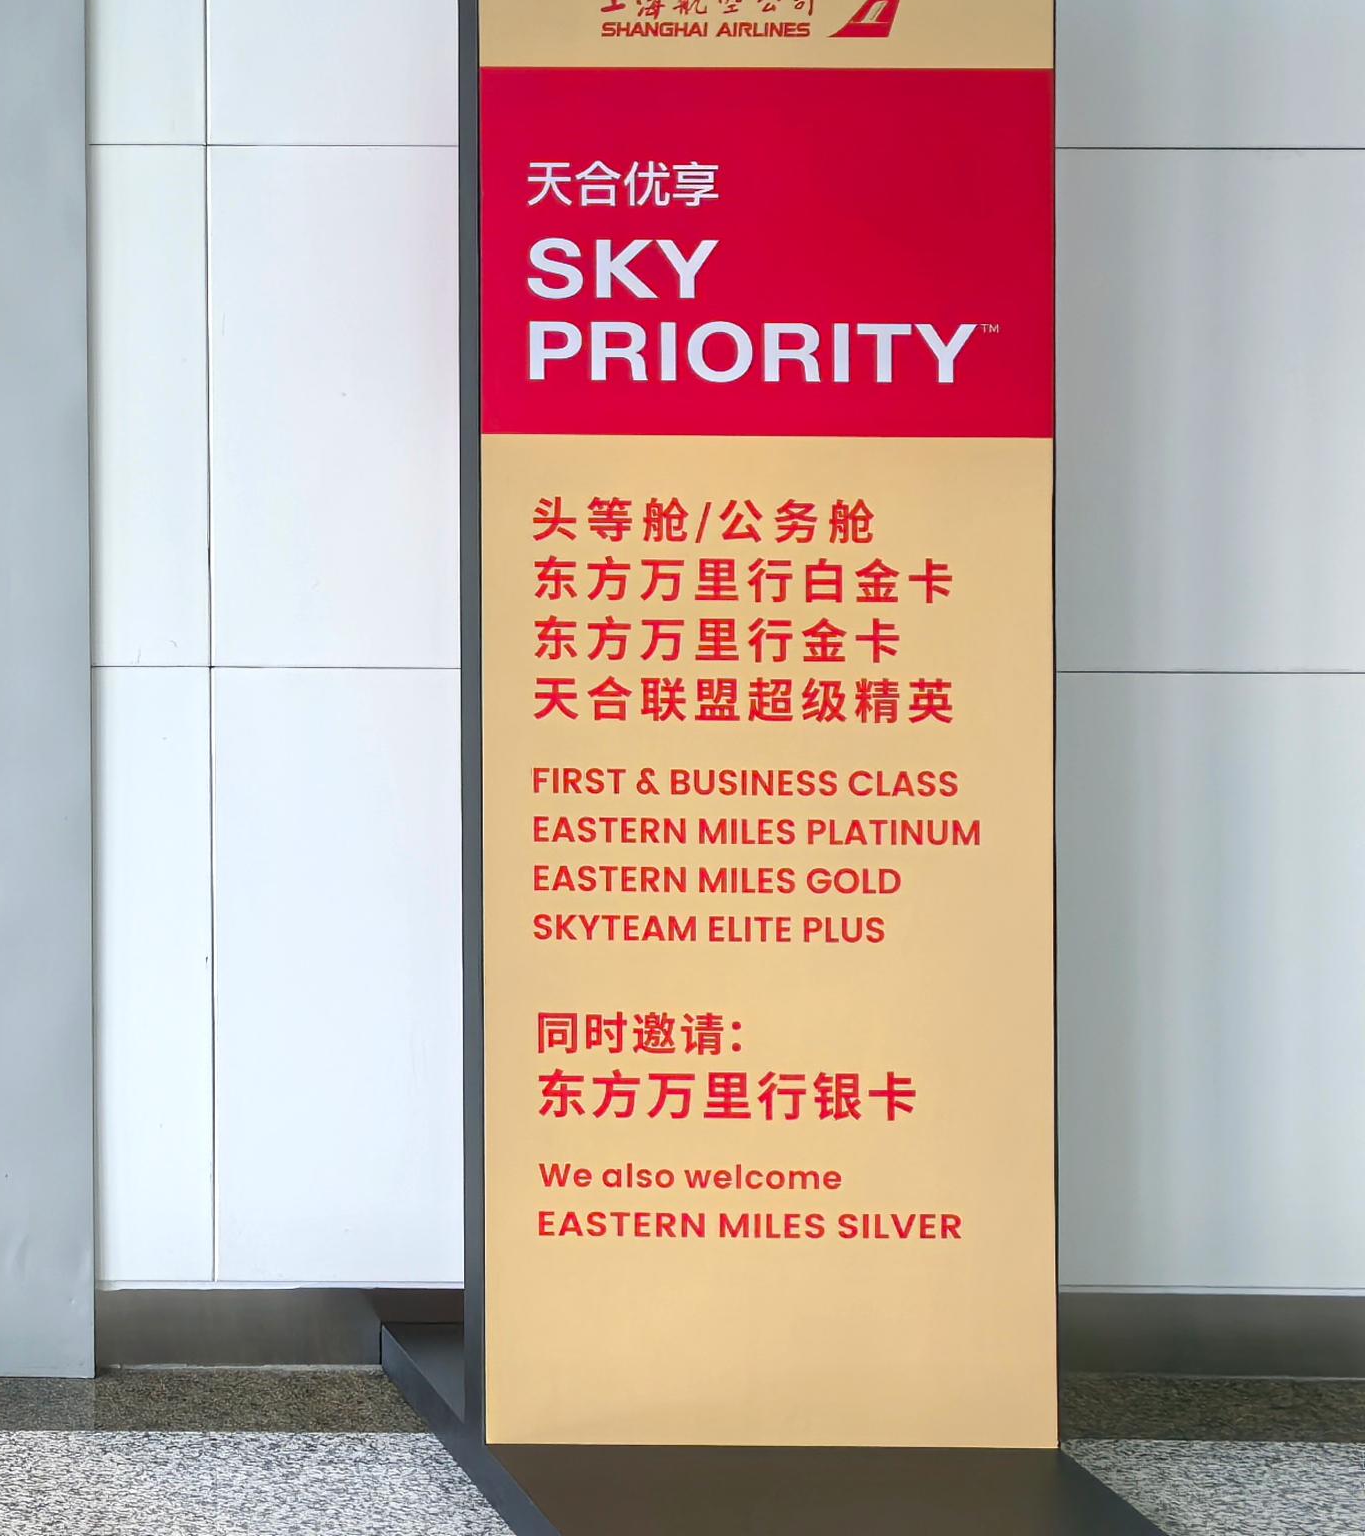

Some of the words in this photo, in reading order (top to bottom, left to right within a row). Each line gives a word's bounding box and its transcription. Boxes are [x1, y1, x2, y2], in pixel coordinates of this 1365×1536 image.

[601, 21, 708, 37] SHANGHAI
[716, 22, 811, 38] AIRLINES
[527, 161, 719, 207] 天合优享
[527, 237, 719, 299] SKY
[529, 321, 978, 383] PRIORITY
[533, 496, 875, 544] 头等舱/公务舱
[534, 555, 954, 604] 东方万里行白金卡
[534, 615, 901, 663] 东方万里行金卡
[533, 675, 954, 724] 天合联盟超级精英
[533, 767, 627, 795] FIRST
[636, 768, 661, 796] &
[670, 769, 838, 797] BUSINESS
[848, 770, 959, 798] CLASS
[533, 816, 687, 845] EASTERN
[698, 818, 796, 845] MILES
[807, 820, 981, 846] PLATINUM
[533, 865, 687, 893] EASTERN
[698, 867, 796, 894] MILES
[806, 868, 902, 895] GOLD
[533, 914, 697, 942] SKYTEAM
[708, 916, 792, 943] ELITE
[803, 917, 886, 944] PLUS
[538, 1068, 917, 1122] 东方万里行银卡
[539, 1163, 593, 1189] We
[601, 1162, 675, 1189] also
[684, 1163, 842, 1190] welcome
[538, 1210, 706, 1238] EASTERN
[719, 1212, 825, 1239] MILES
[838, 1213, 962, 1240] SILVER
